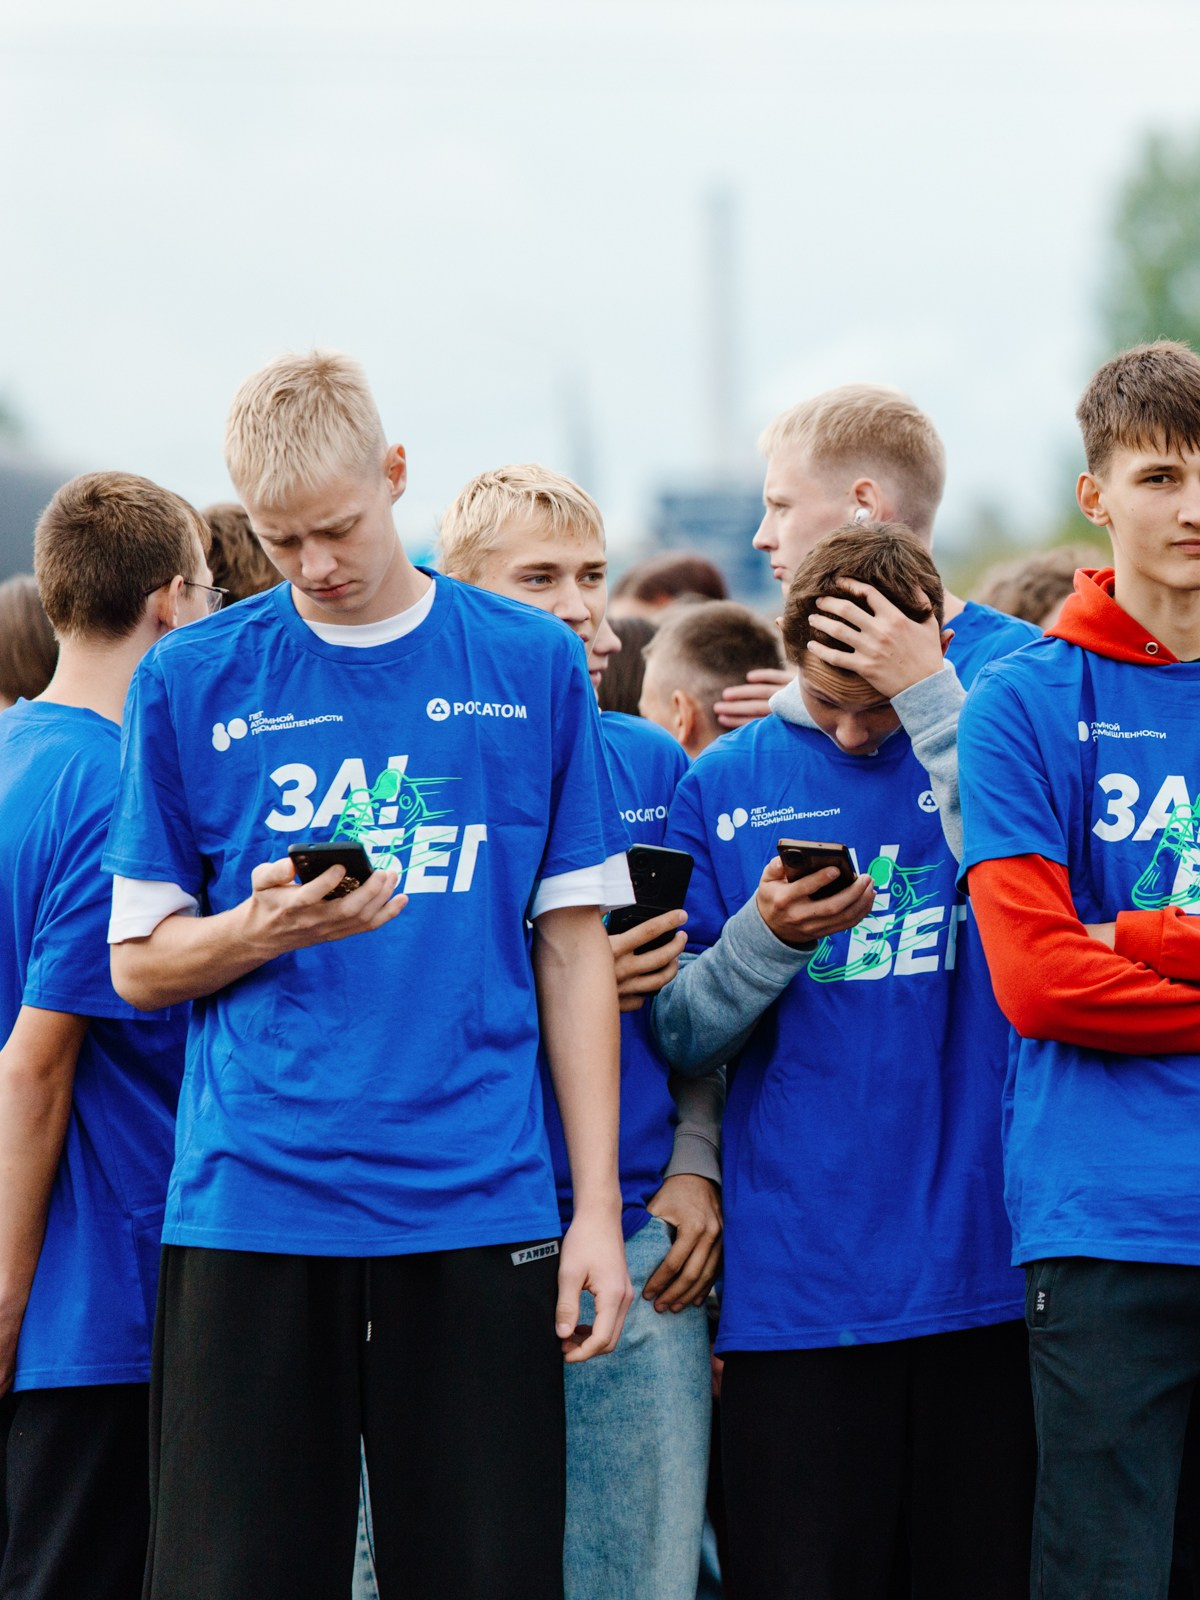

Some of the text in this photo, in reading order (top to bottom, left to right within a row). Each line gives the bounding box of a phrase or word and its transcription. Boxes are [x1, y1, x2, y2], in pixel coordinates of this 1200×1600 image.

[248, 710, 264, 721] ЛЕТ
[453, 701, 527, 719] РОСАТОМ
[250, 712, 294, 729] АТОМНОЙ
[264, 755, 409, 832] ЗА!
[750, 806, 767, 815] ЛЕТ
[750, 806, 794, 822] АТОМНОЙ
[750, 808, 841, 828] ПРОМЫШЛЕННОСТИ
